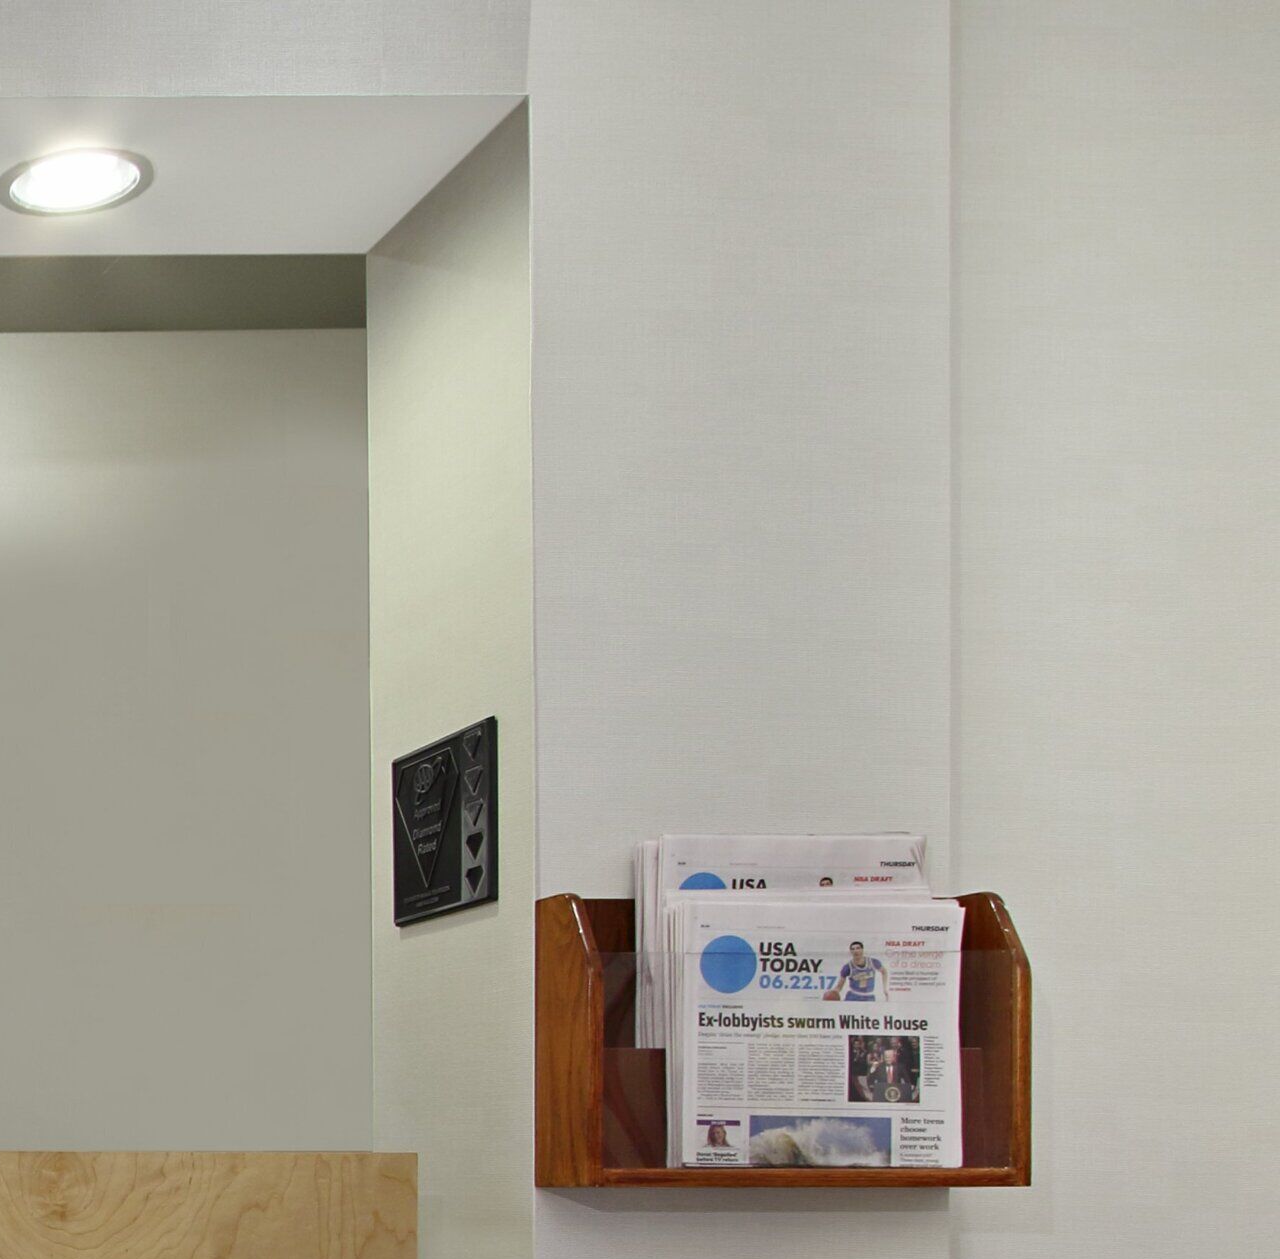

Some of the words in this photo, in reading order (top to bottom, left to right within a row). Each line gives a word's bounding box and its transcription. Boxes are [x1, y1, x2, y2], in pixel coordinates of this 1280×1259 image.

[732, 878, 767, 889] USA
[759, 941, 797, 957] USA
[759, 958, 823, 973] TODAY
[759, 974, 837, 989] 06.22.17
[698, 1012, 784, 1031] Ex-lobbyists
[787, 1016, 835, 1029] swarm
[839, 1015, 880, 1030] White
[884, 1016, 928, 1030] House
